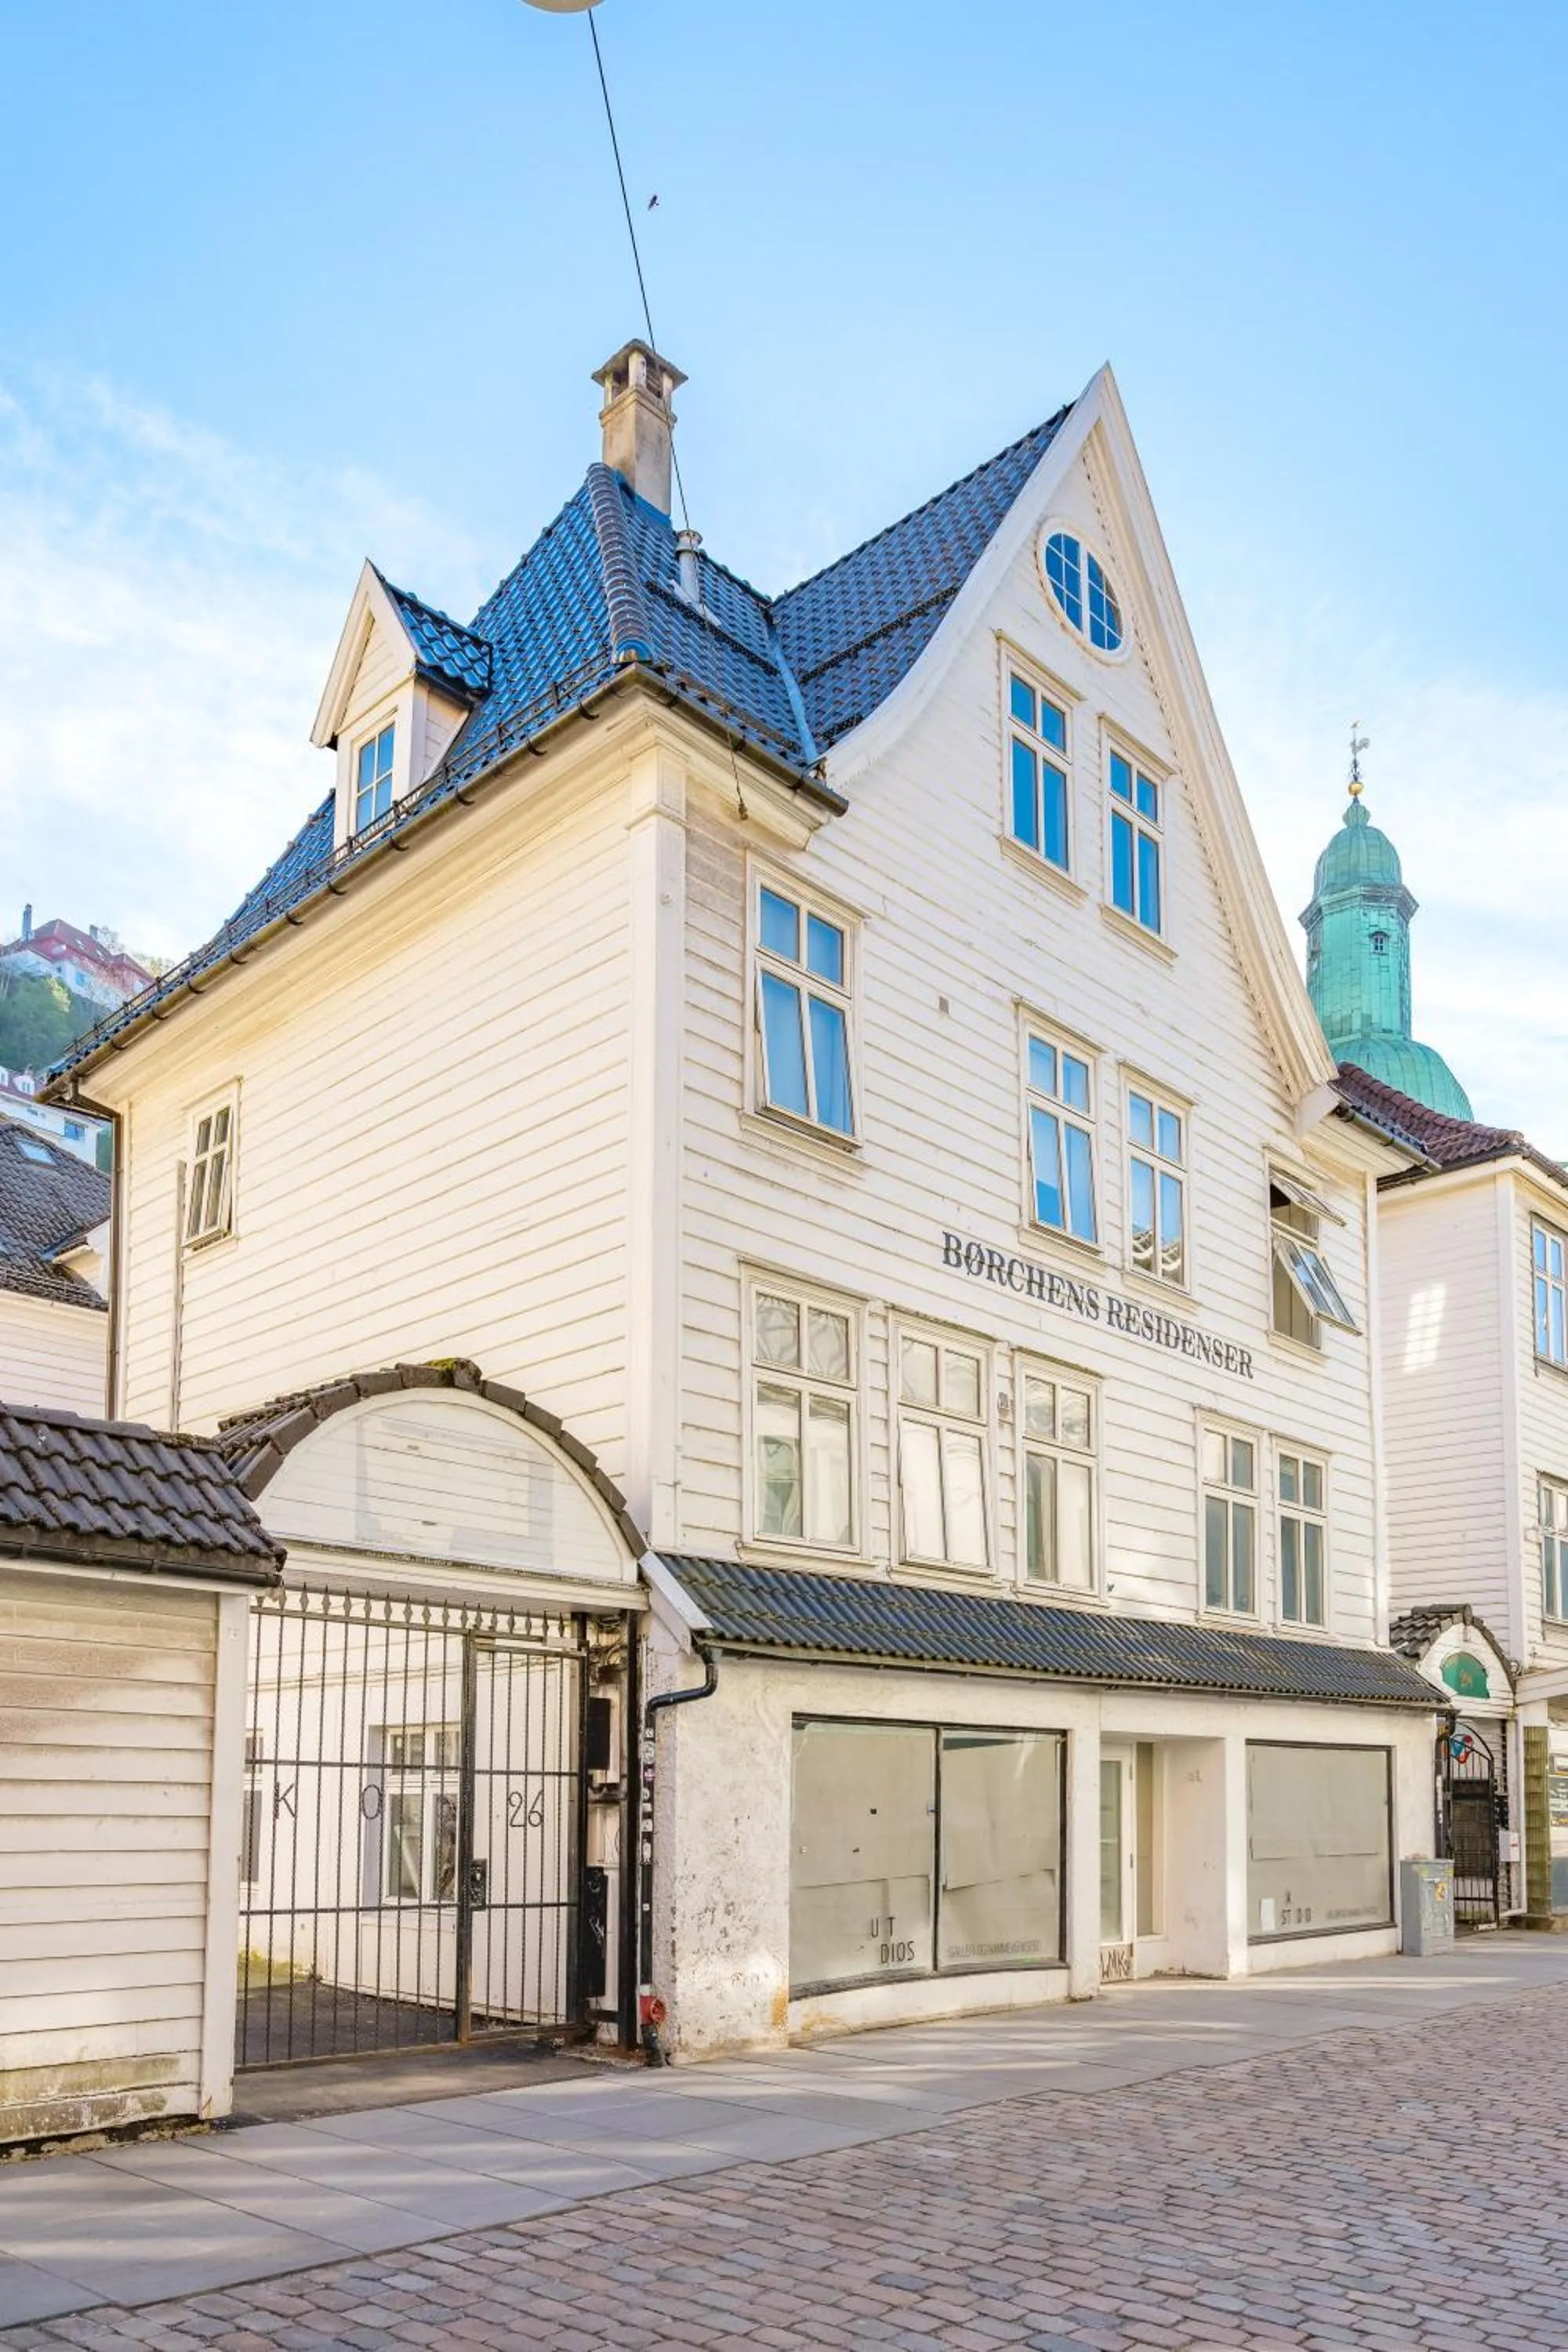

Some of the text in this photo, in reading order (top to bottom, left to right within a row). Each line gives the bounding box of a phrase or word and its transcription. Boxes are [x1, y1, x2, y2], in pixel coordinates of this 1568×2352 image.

[942, 1231, 1254, 1379] BØRCHENS RESIDENSER
[508, 1789, 544, 1828] 26
